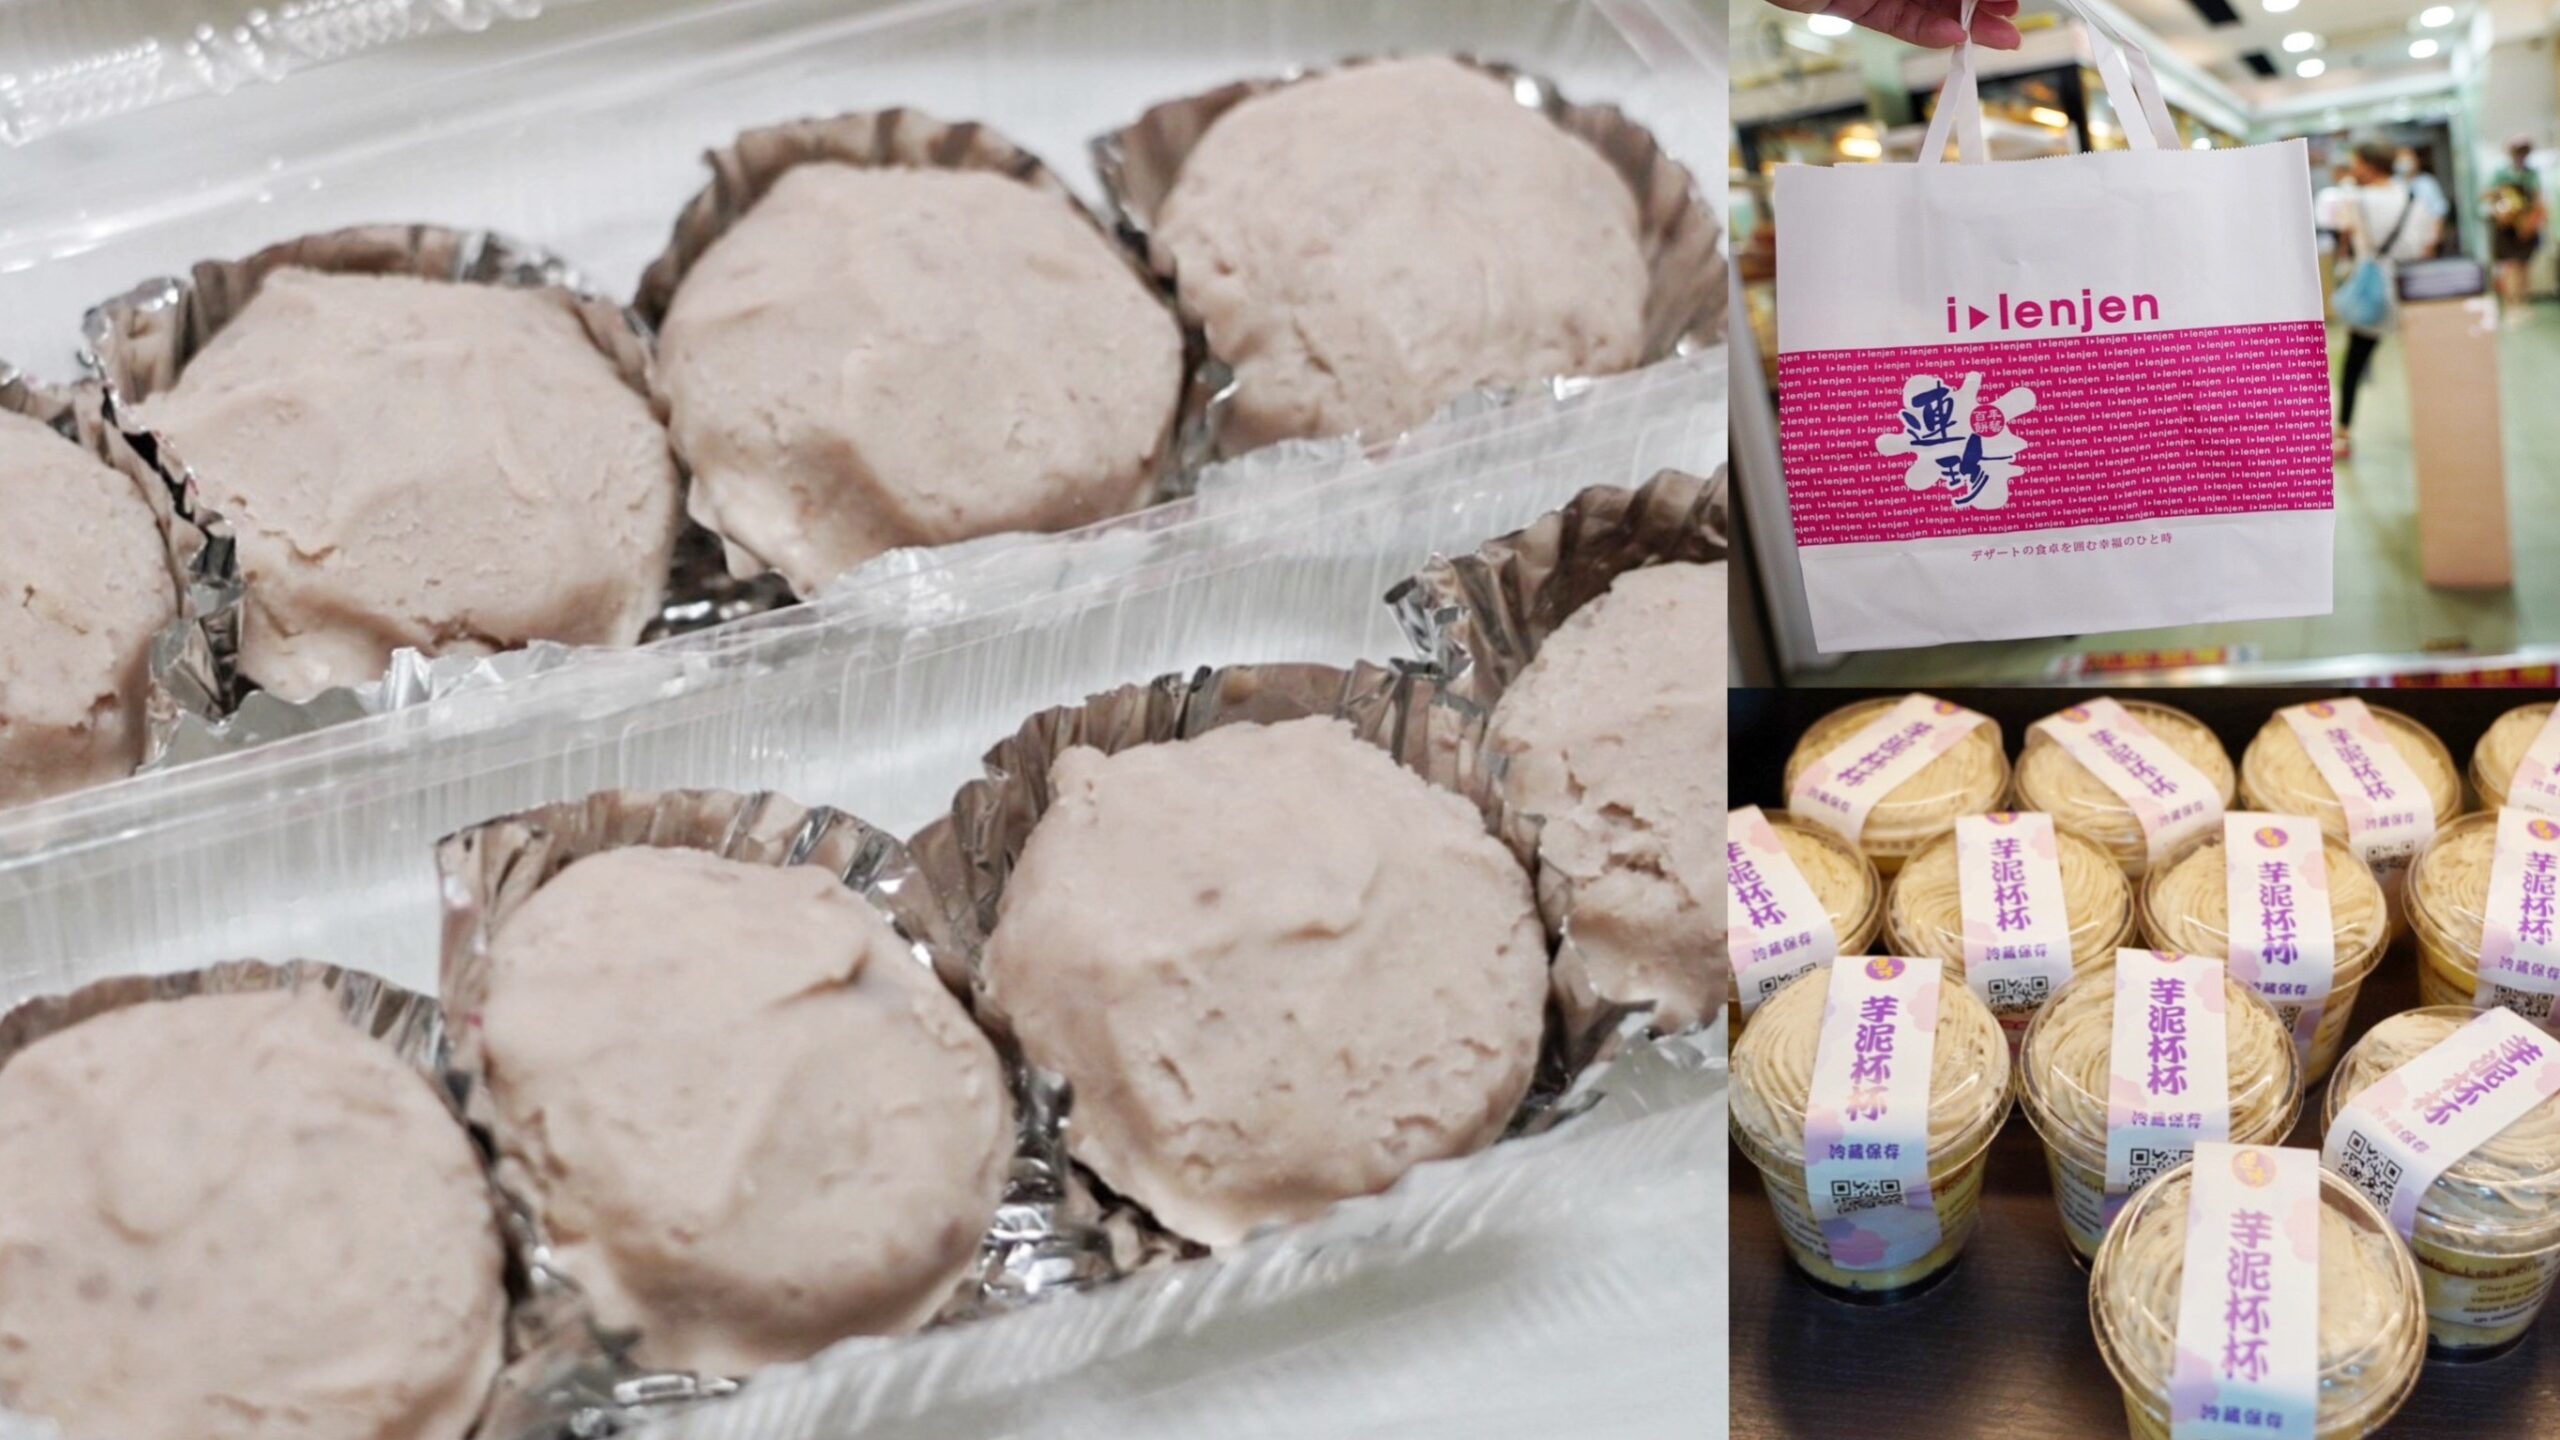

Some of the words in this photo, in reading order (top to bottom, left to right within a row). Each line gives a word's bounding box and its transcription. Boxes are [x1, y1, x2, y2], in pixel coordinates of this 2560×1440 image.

[1971, 532, 2173, 562] デザートの食卓を囲む幸福のひと時
[2326, 728, 2395, 800] 芋泥杯杯
[1990, 838, 2031, 932] 芋泥杯杯
[2258, 861, 2298, 966] 芋泥杯杯
[2518, 851, 2558, 946] 芋泥杯杯
[1752, 931, 1812, 963] 冷藏保存
[1986, 944, 2047, 960] 冷藏保存
[1846, 995, 1899, 1122] 芋泥杯杯
[2147, 977, 2188, 1096] 芋泥杯杯
[2132, 1111, 2202, 1129] 冷藏保存
[2412, 1034, 2544, 1126] 芋泥杯杯
[1829, 1143, 1900, 1160] 冷藏保存
[2222, 1208, 2273, 1383] 芋泥杯杯
[2200, 1403, 2283, 1429] 冷藏保存
